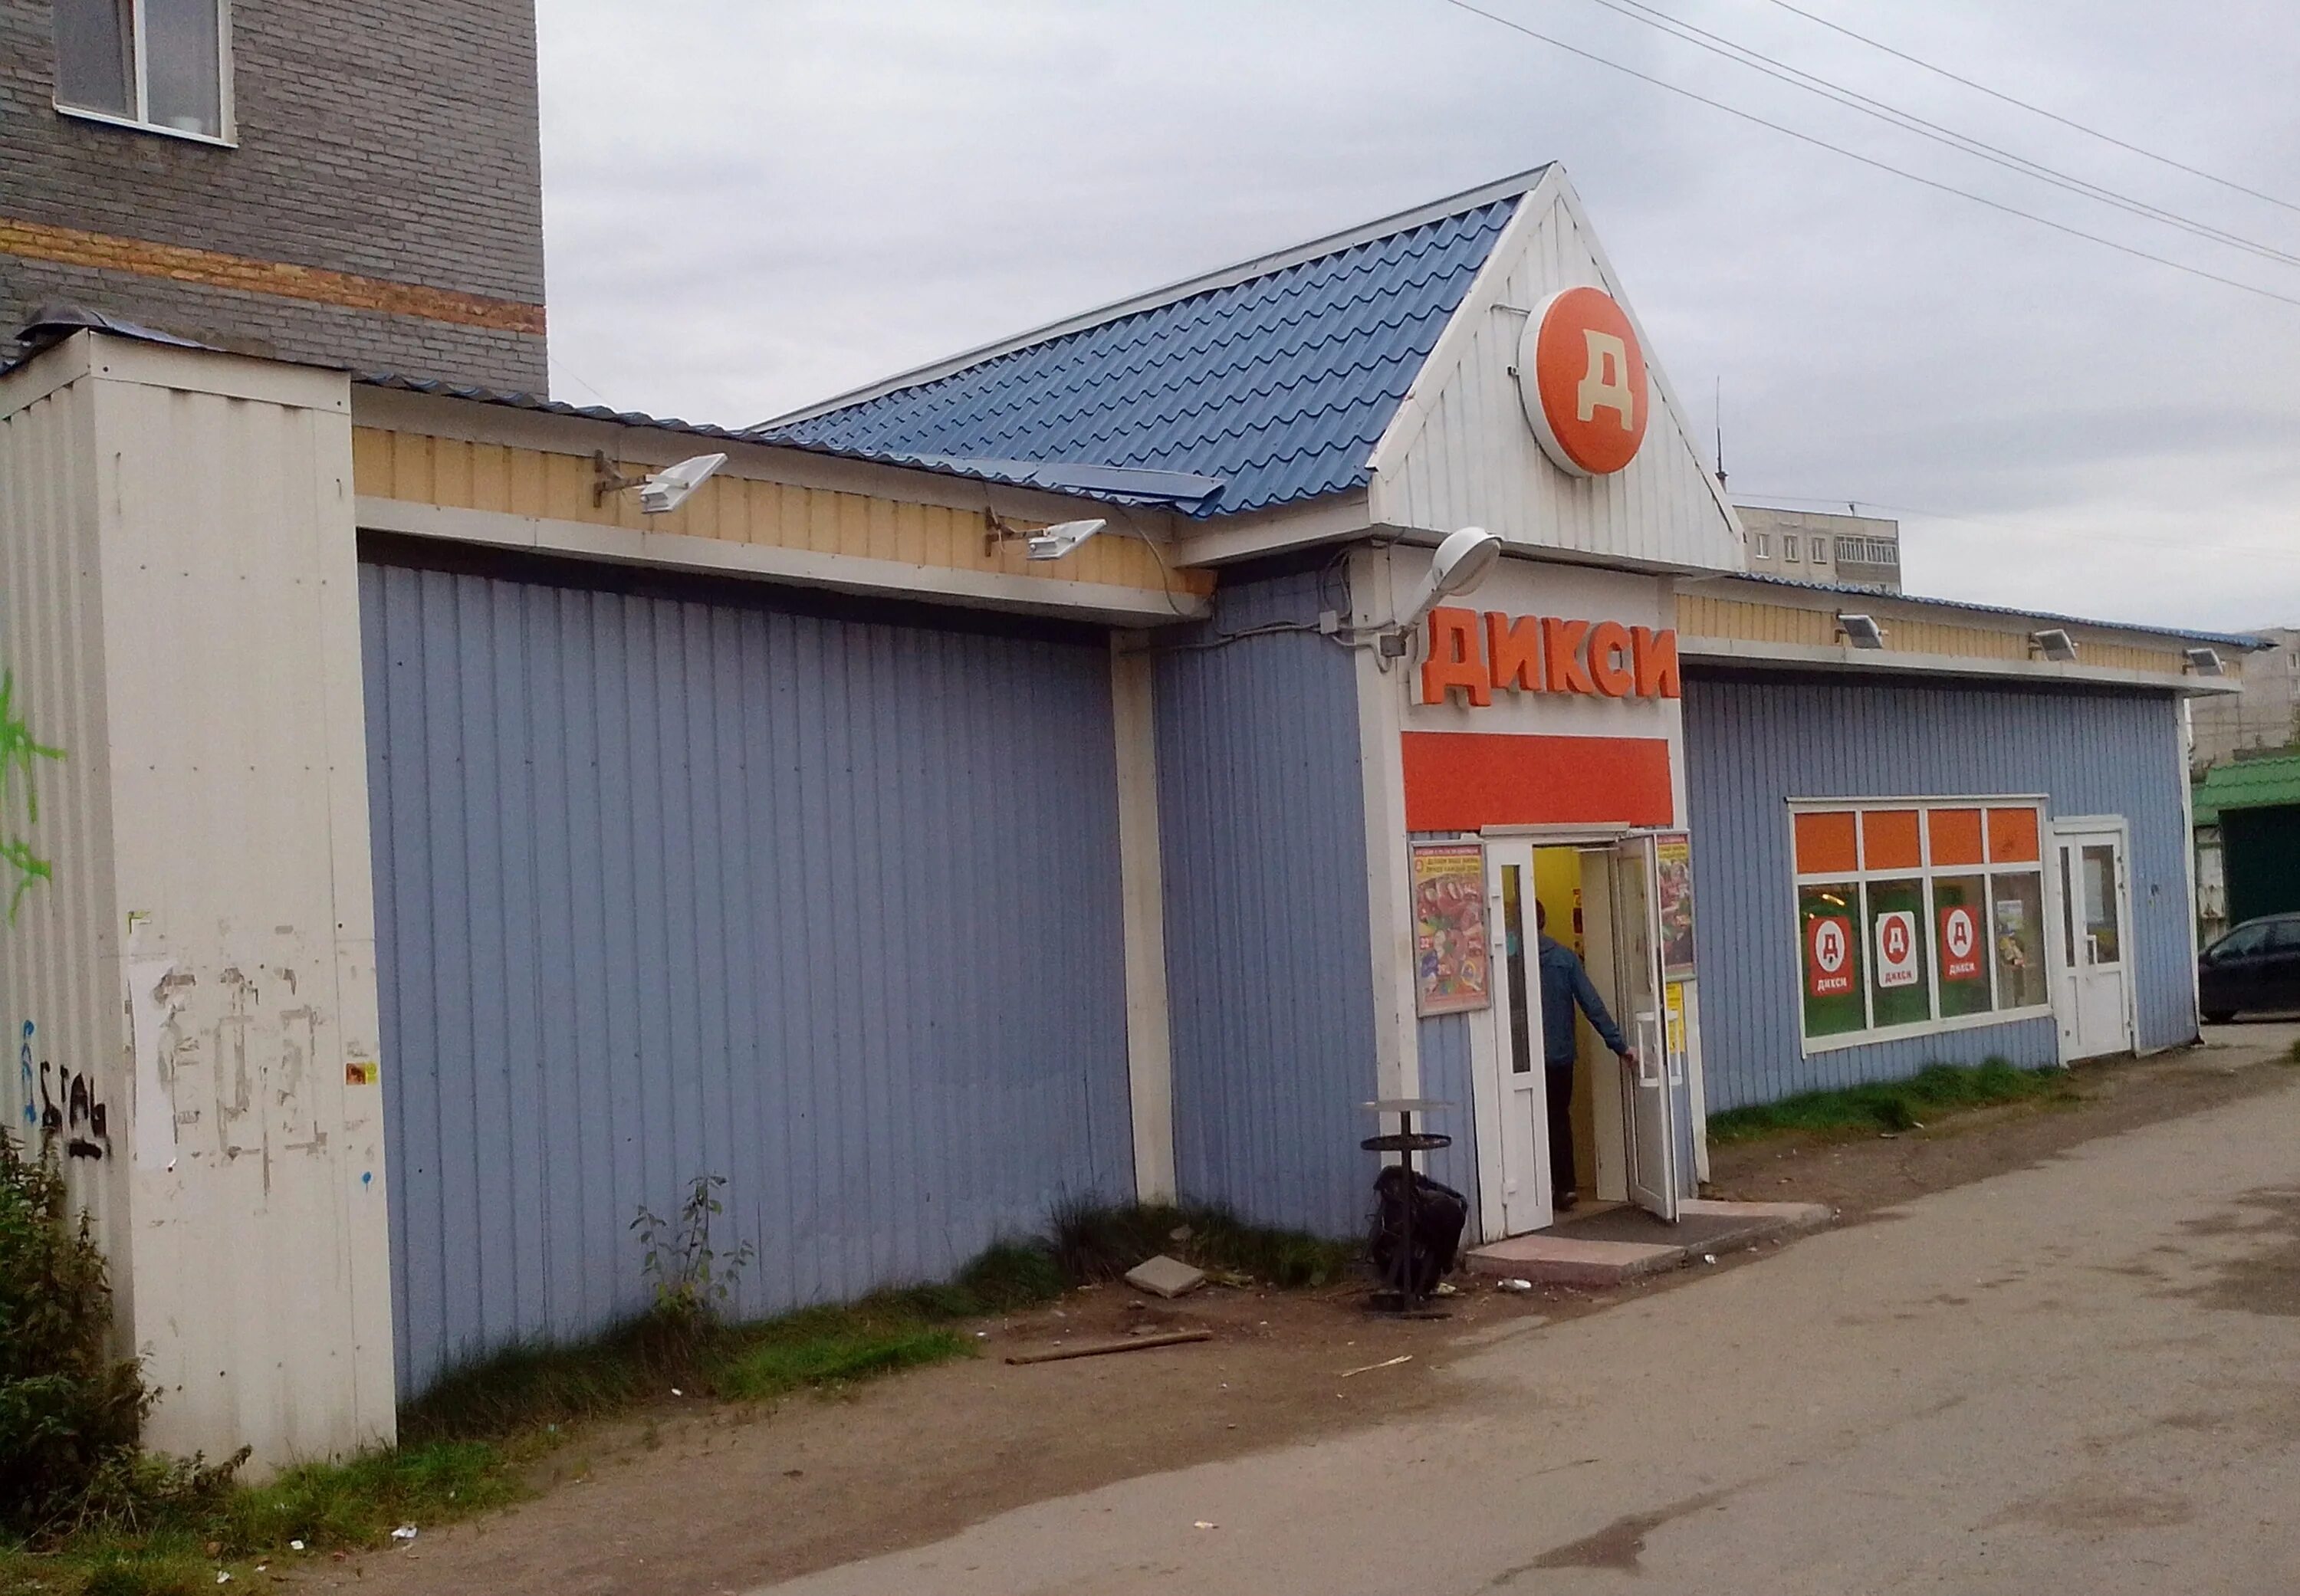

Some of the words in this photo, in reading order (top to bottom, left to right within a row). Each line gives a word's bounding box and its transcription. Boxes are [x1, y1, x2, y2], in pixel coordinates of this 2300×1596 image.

[1576, 329, 1634, 431] Д
[1418, 606, 1681, 707] ДИКСИ
[1889, 927, 1905, 954] Д
[1953, 921, 1967, 945] Д
[1822, 933, 1838, 960] Д
[1884, 970, 1912, 984] ДИКСИ
[1949, 962, 1976, 976] ДИКСИ
[1817, 977, 1847, 992] ДИКСИ
